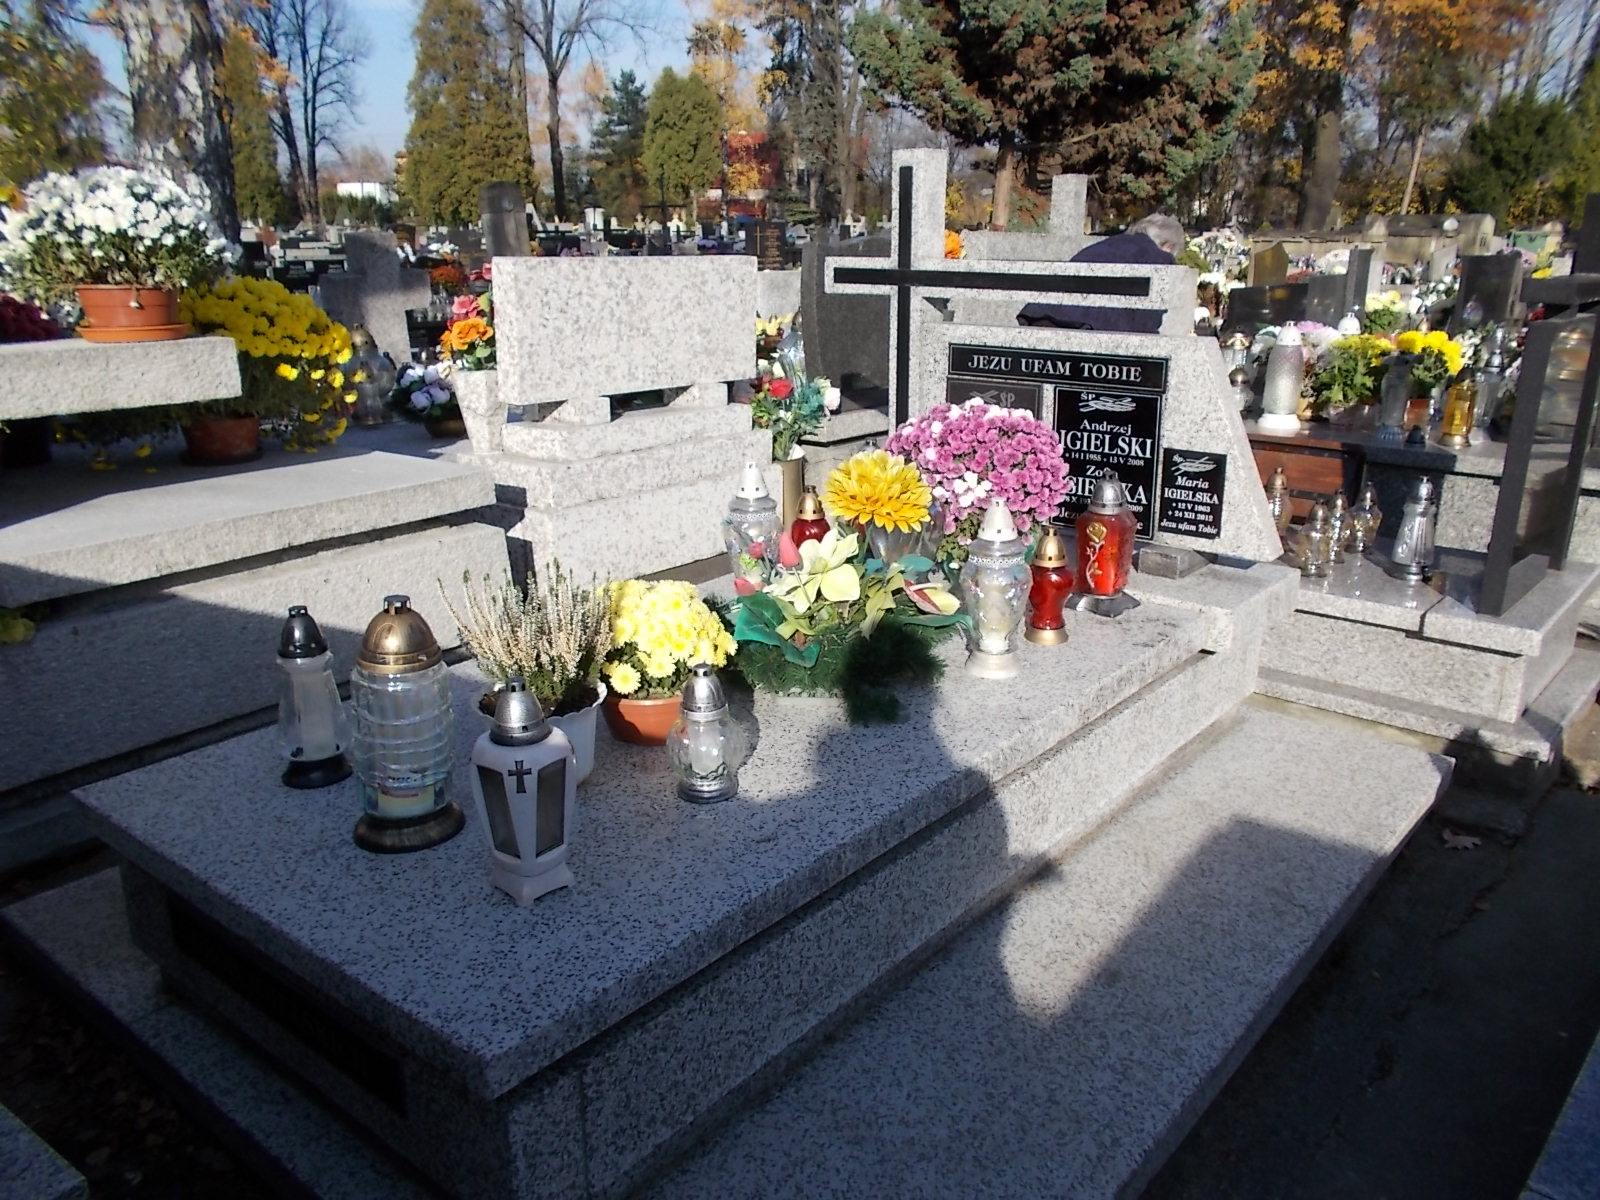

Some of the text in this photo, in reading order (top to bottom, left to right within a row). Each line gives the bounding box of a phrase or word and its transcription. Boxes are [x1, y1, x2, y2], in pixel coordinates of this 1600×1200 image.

[968, 355, 1143, 383] JEZU UFAM TOBIE
[1079, 418, 1132, 436] Andrzej
[1059, 429, 1153, 458] IGIELSKI
[1126, 457, 1144, 467] 2008
[1063, 475, 1148, 505] GIEKA
[1175, 475, 1210, 489] Maria
[1163, 487, 1219, 505] IGIELSKA
[1183, 511, 1195, 520] XII
[1196, 513, 1213, 522] 2012
[1178, 522, 1196, 532] ufam
[1198, 523, 1218, 535] Tobie
